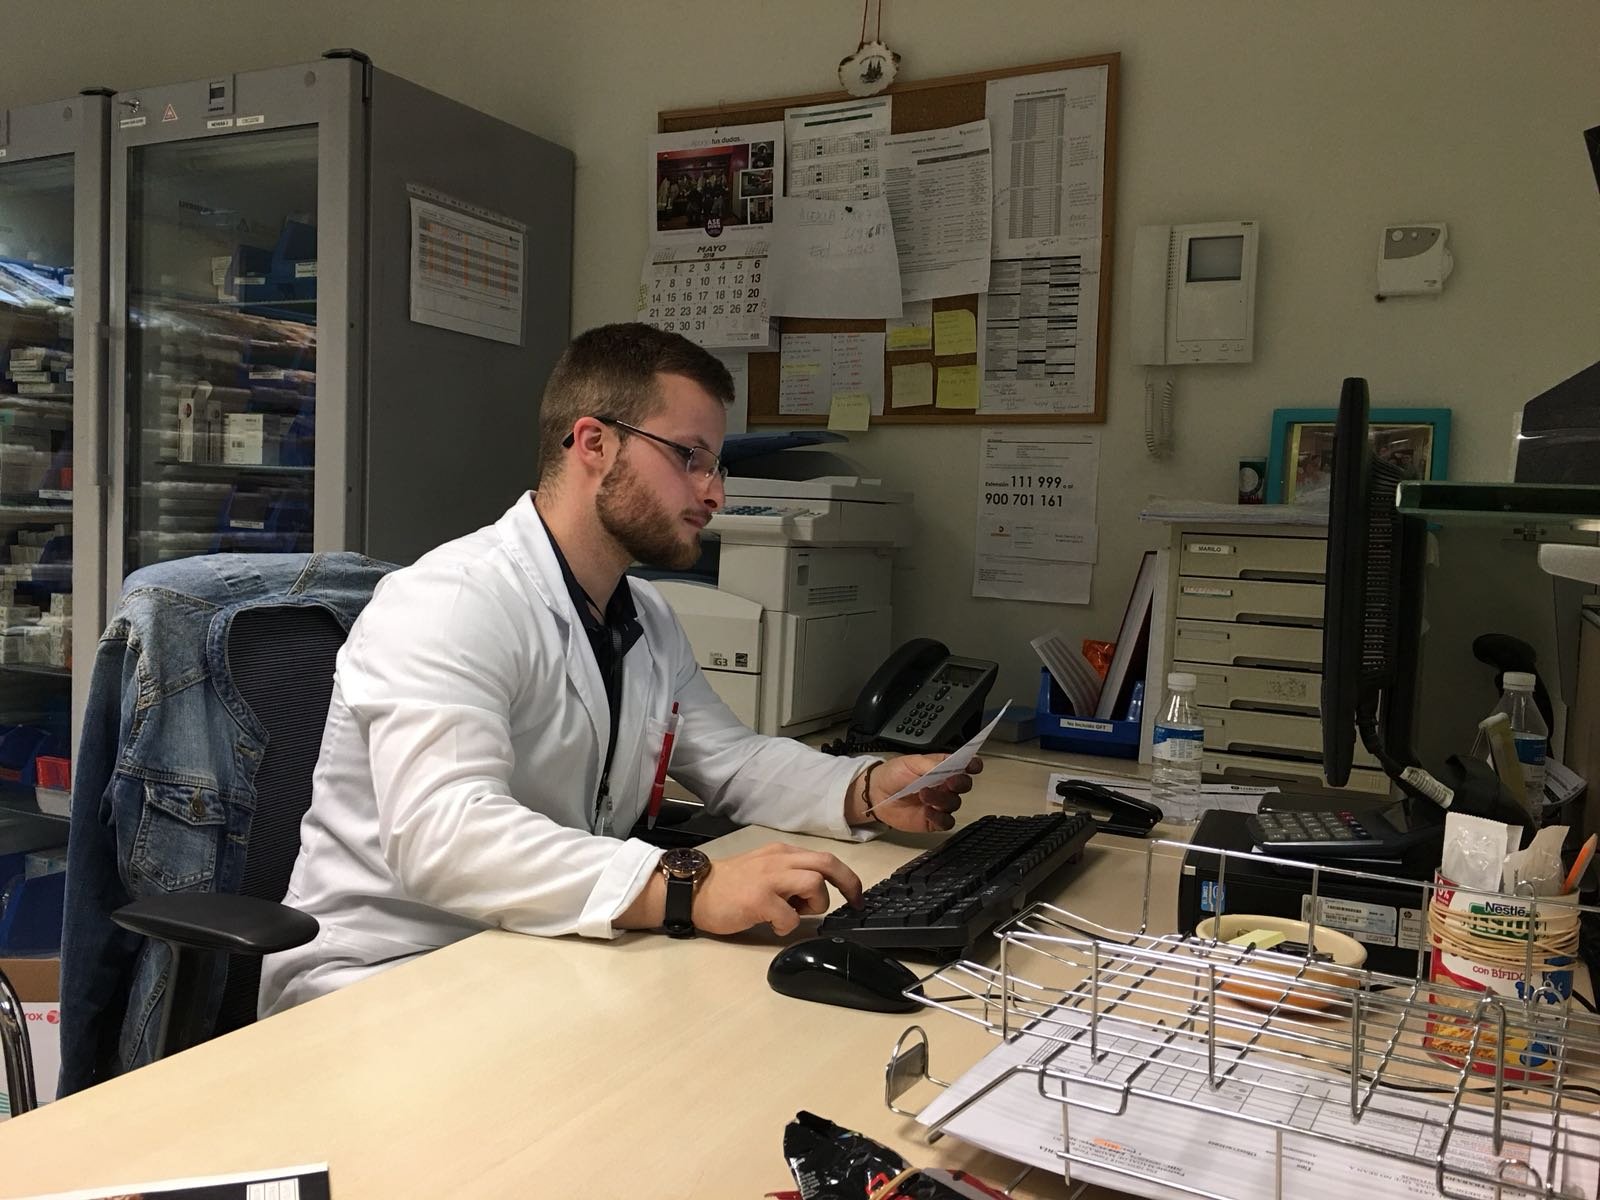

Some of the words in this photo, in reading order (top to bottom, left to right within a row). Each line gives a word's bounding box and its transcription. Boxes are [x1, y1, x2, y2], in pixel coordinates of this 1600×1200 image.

[697, 244, 727, 254] MAYO
[673, 265, 678, 273] 1
[689, 264, 695, 273] 2
[704, 263, 710, 272] 3
[719, 262, 725, 270] 4
[737, 261, 743, 269] 5
[754, 259, 761, 269] 6
[655, 280, 661, 289] 7
[669, 279, 675, 288] 8
[686, 277, 692, 287] 9
[700, 276, 710, 286] 10
[718, 275, 726, 285] 11
[734, 275, 744, 284] 12
[751, 273, 761, 283] 13
[652, 294, 661, 303] 14
[666, 292, 676, 302] 15
[683, 292, 692, 301] 16
[699, 291, 709, 301] 17
[716, 290, 725, 300] 18
[732, 289, 742, 299] 19
[747, 288, 760, 298] 20
[649, 308, 659, 318] 21
[664, 307, 675, 317] 22
[680, 307, 691, 316] 23
[696, 305, 707, 316] 24
[712, 305, 724, 314] 25
[729, 304, 741, 314] 26
[746, 303, 759, 313] 27
[664, 322, 675, 331] 29
[679, 321, 691, 331] 30
[695, 320, 705, 330] 31
[1010, 475, 1032, 488] 111
[1038, 476, 1062, 489] 999
[985, 493, 1008, 505] 900
[1012, 494, 1034, 506] 701
[1041, 495, 1063, 507] 161
[1486, 902, 1526, 917] Nestlé
[1472, 965, 1490, 976] con
[24, 1012, 43, 1021] rox
